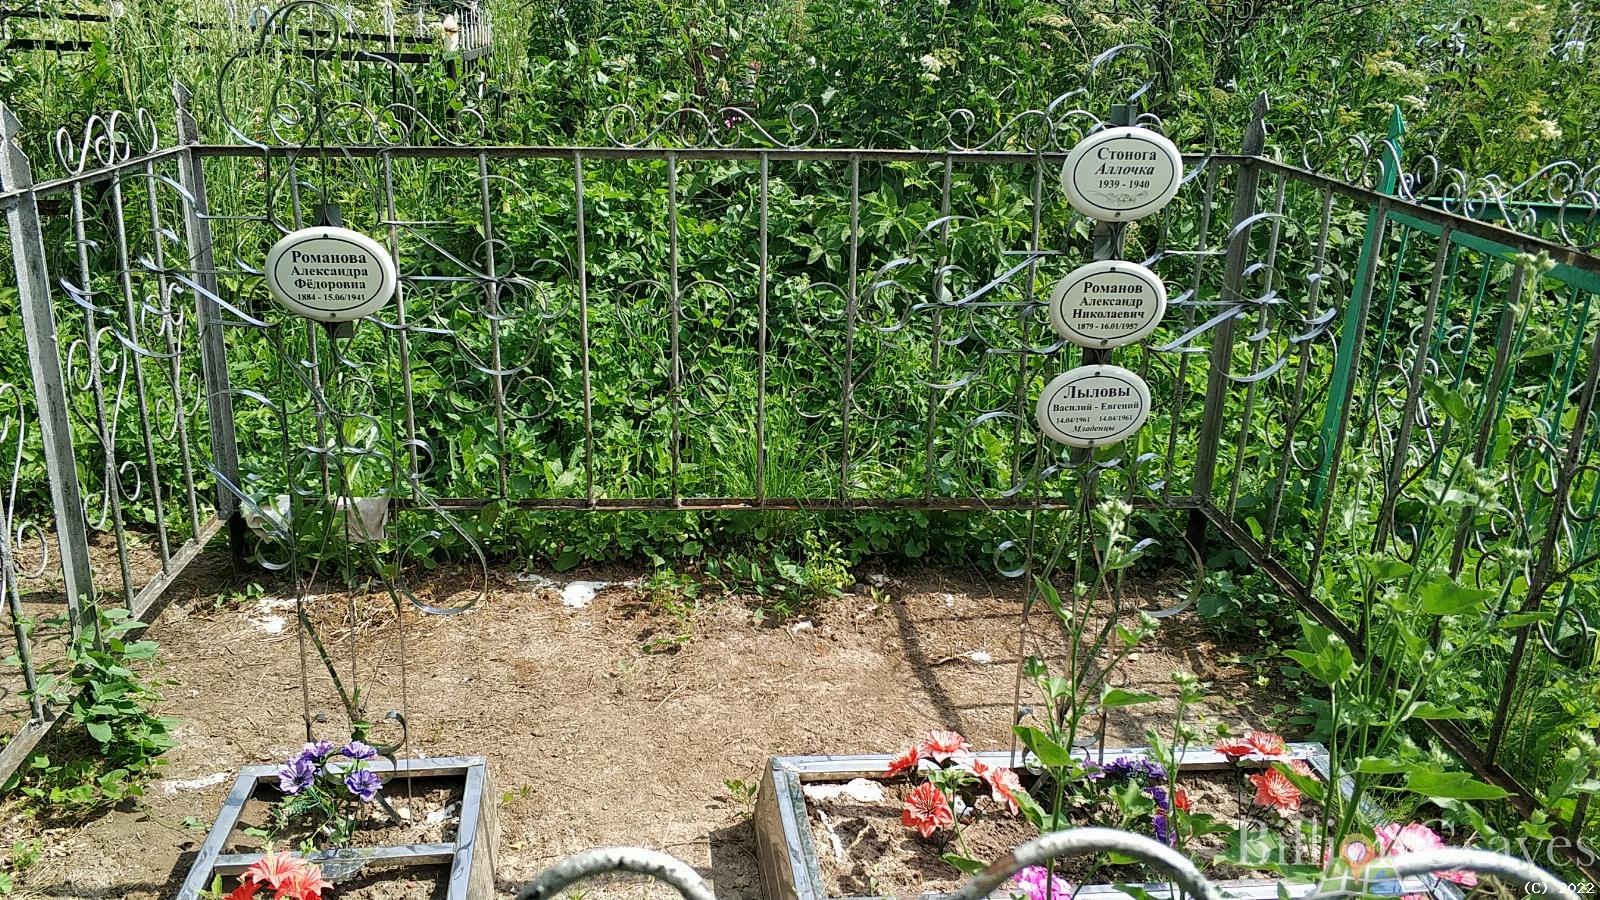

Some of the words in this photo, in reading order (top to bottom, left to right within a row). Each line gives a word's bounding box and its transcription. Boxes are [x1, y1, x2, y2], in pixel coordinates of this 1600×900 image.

[1097, 147, 1157, 161] Стонога
[1094, 162, 1155, 176] Аллочка
[1098, 179, 1120, 189] 1939
[1129, 179, 1150, 189] 1940
[291, 250, 367, 264] Романова
[291, 265, 368, 279] Александра
[294, 278, 366, 292] Фёдоровна
[1083, 281, 1143, 294] Романов
[297, 293, 316, 301] 1884
[324, 293, 365, 301] 15.06/1941
[1080, 296, 1143, 309] Александр
[1072, 308, 1145, 319] Николаевич
[1063, 385, 1131, 399] Лыловы
[1052, 403, 1092, 412] Василий
[1101, 401, 1139, 411] Евгений
[1056, 416, 1090, 424] 14.04/1961
[1099, 414, 1133, 422] 14.04/1961
[1072, 425, 1115, 433] Младенцы
